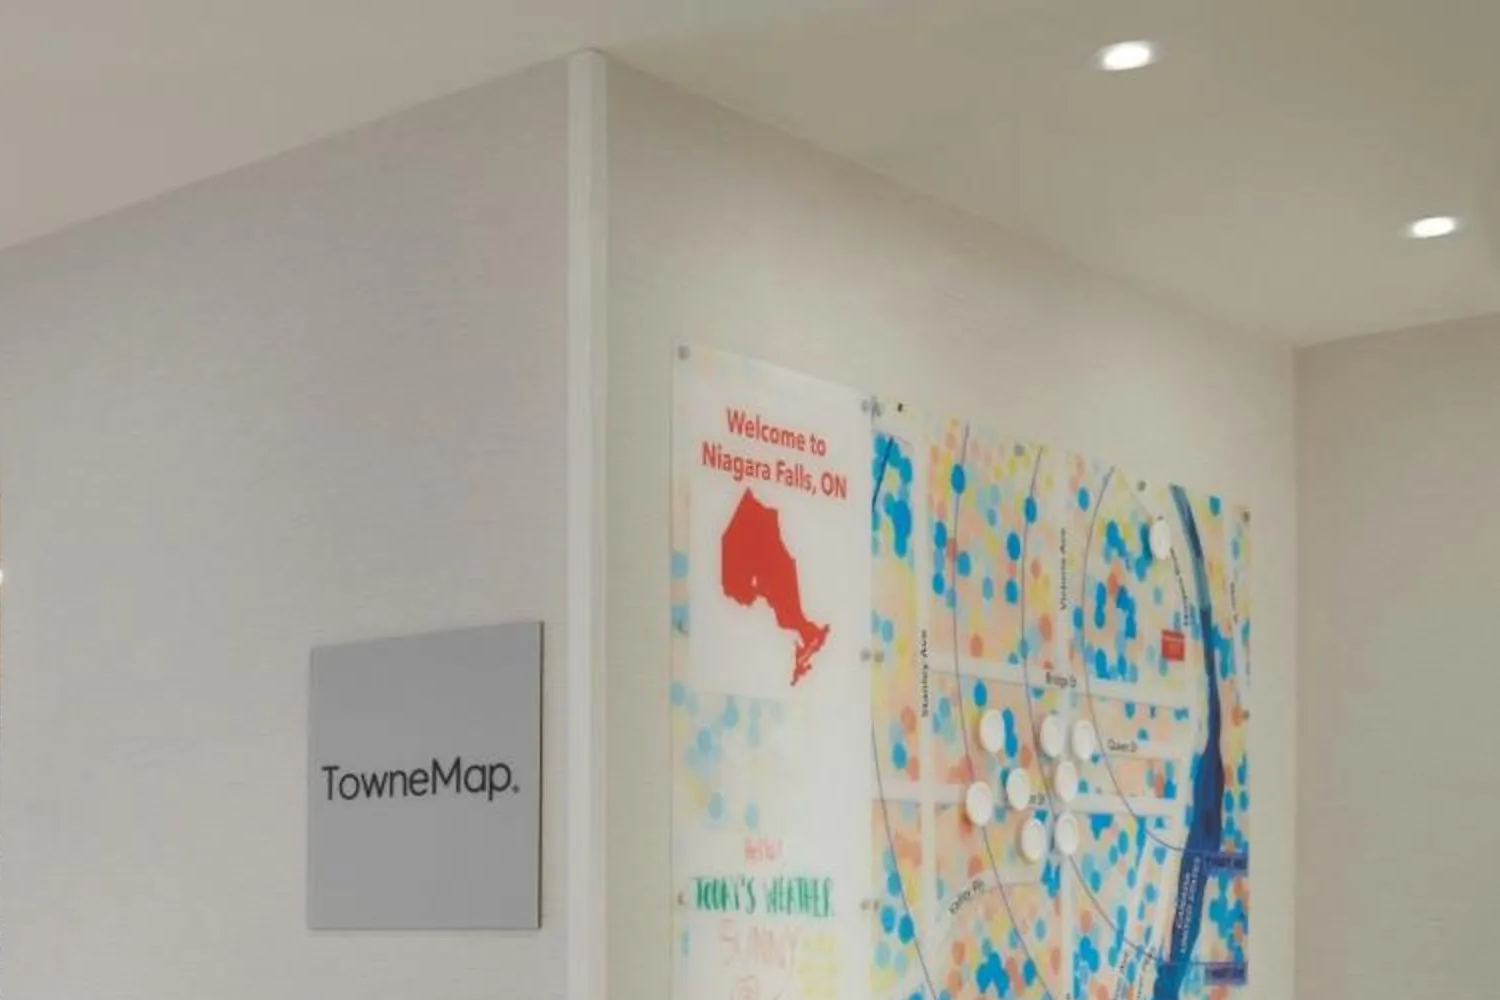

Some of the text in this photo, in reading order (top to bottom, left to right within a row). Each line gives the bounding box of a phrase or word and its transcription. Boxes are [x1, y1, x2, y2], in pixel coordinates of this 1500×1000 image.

[726, 408, 827, 457] Welcome to
[702, 440, 847, 499] Niagara Falls, ON
[321, 756, 520, 802] TowneMap.
